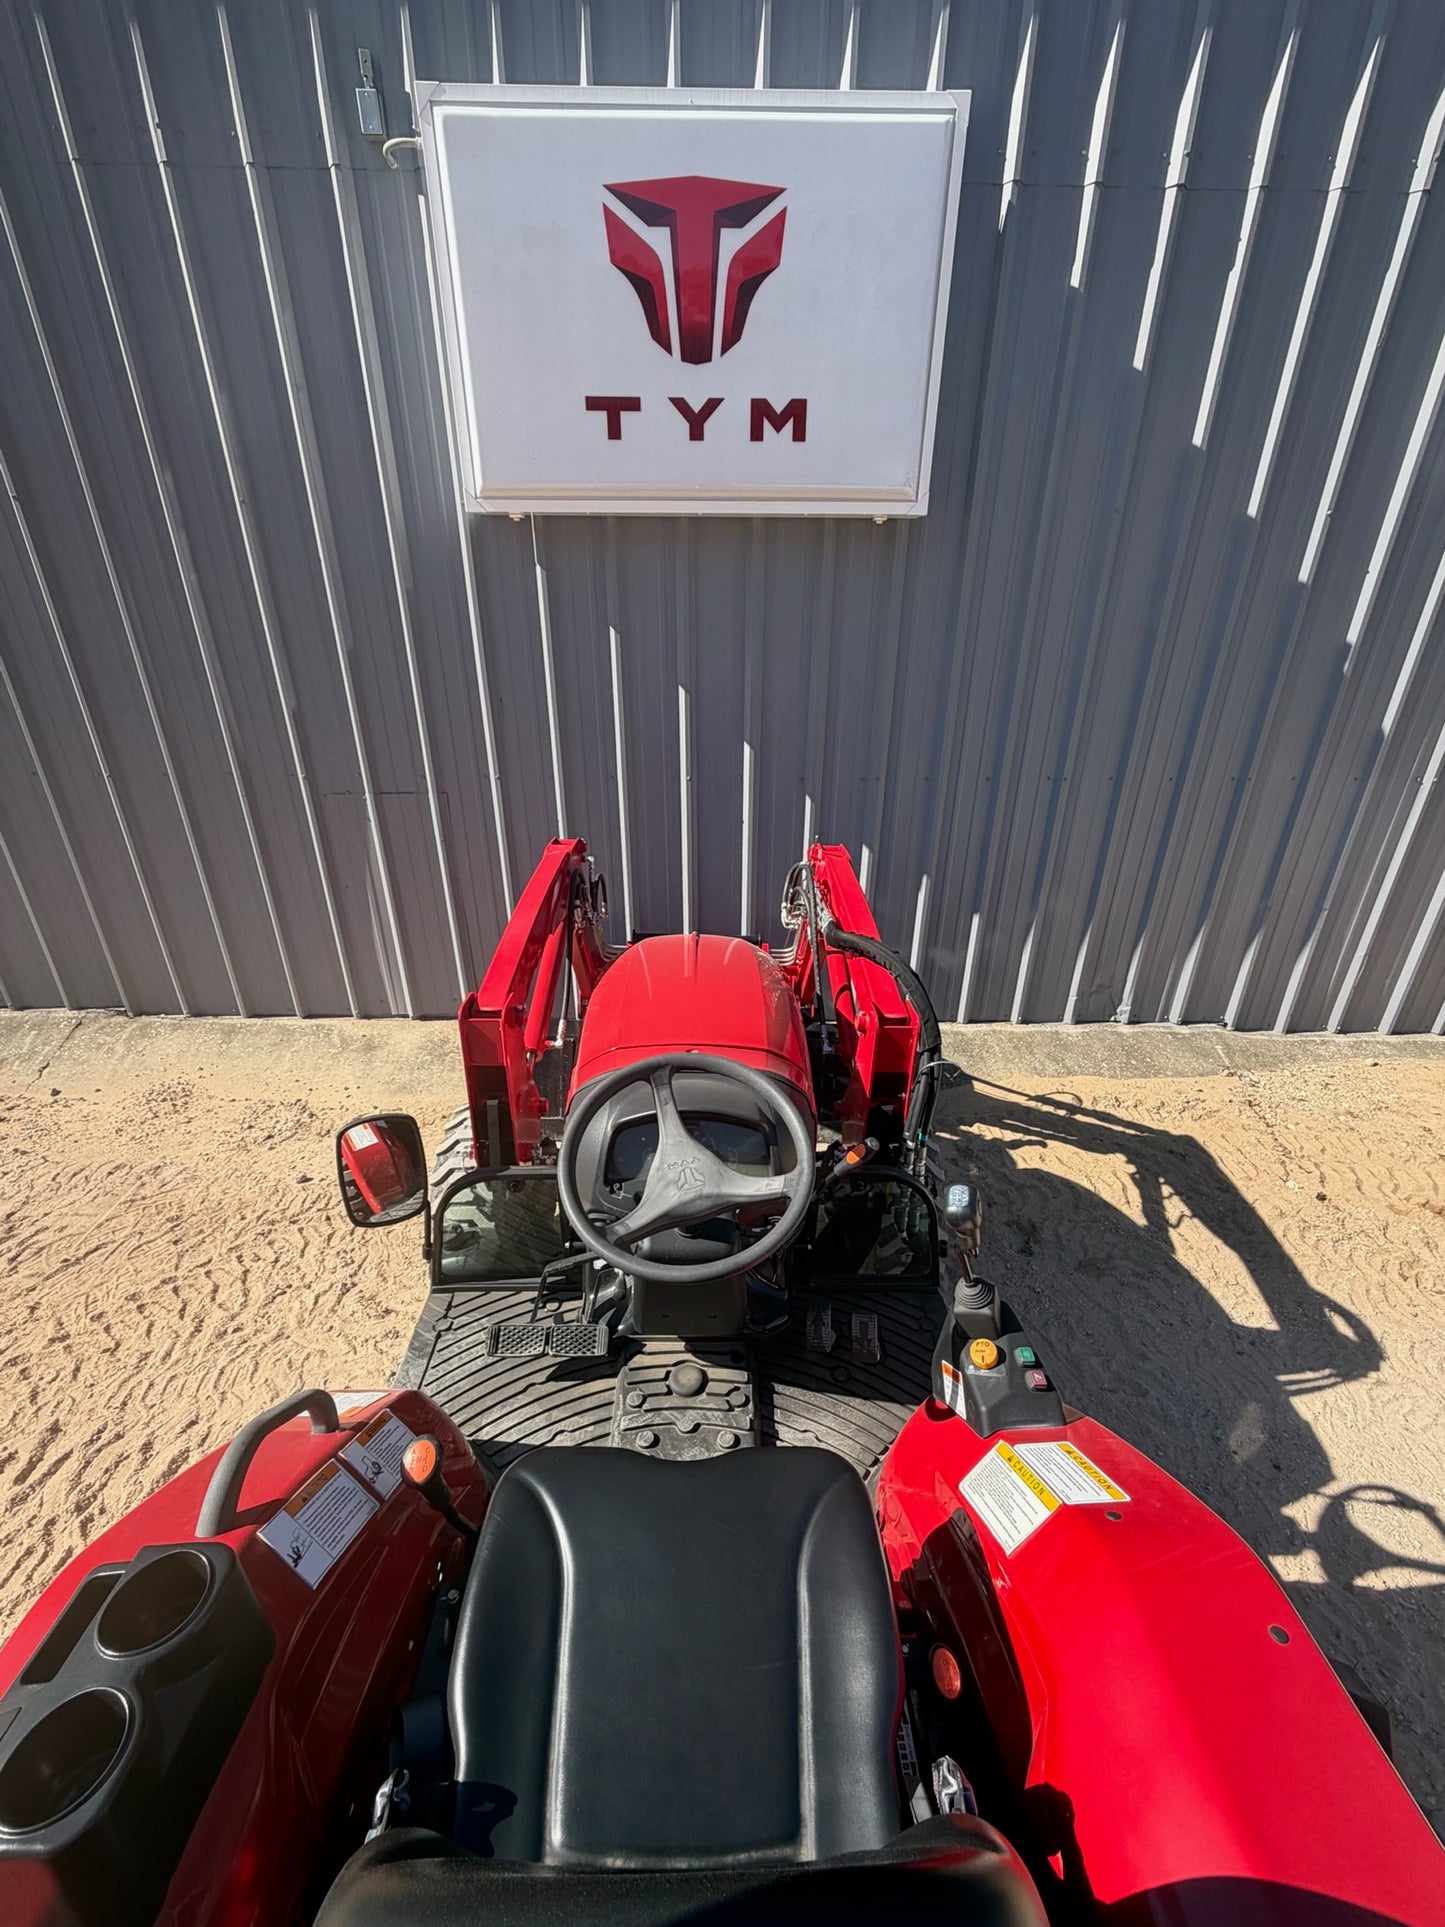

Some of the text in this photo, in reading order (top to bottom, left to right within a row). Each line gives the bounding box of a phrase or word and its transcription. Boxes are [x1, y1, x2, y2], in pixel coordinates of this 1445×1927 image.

[585, 396, 807, 442] TYM
[1012, 1459, 1046, 1496] CAUTION
[1072, 1453, 1114, 1490] CAUTION
